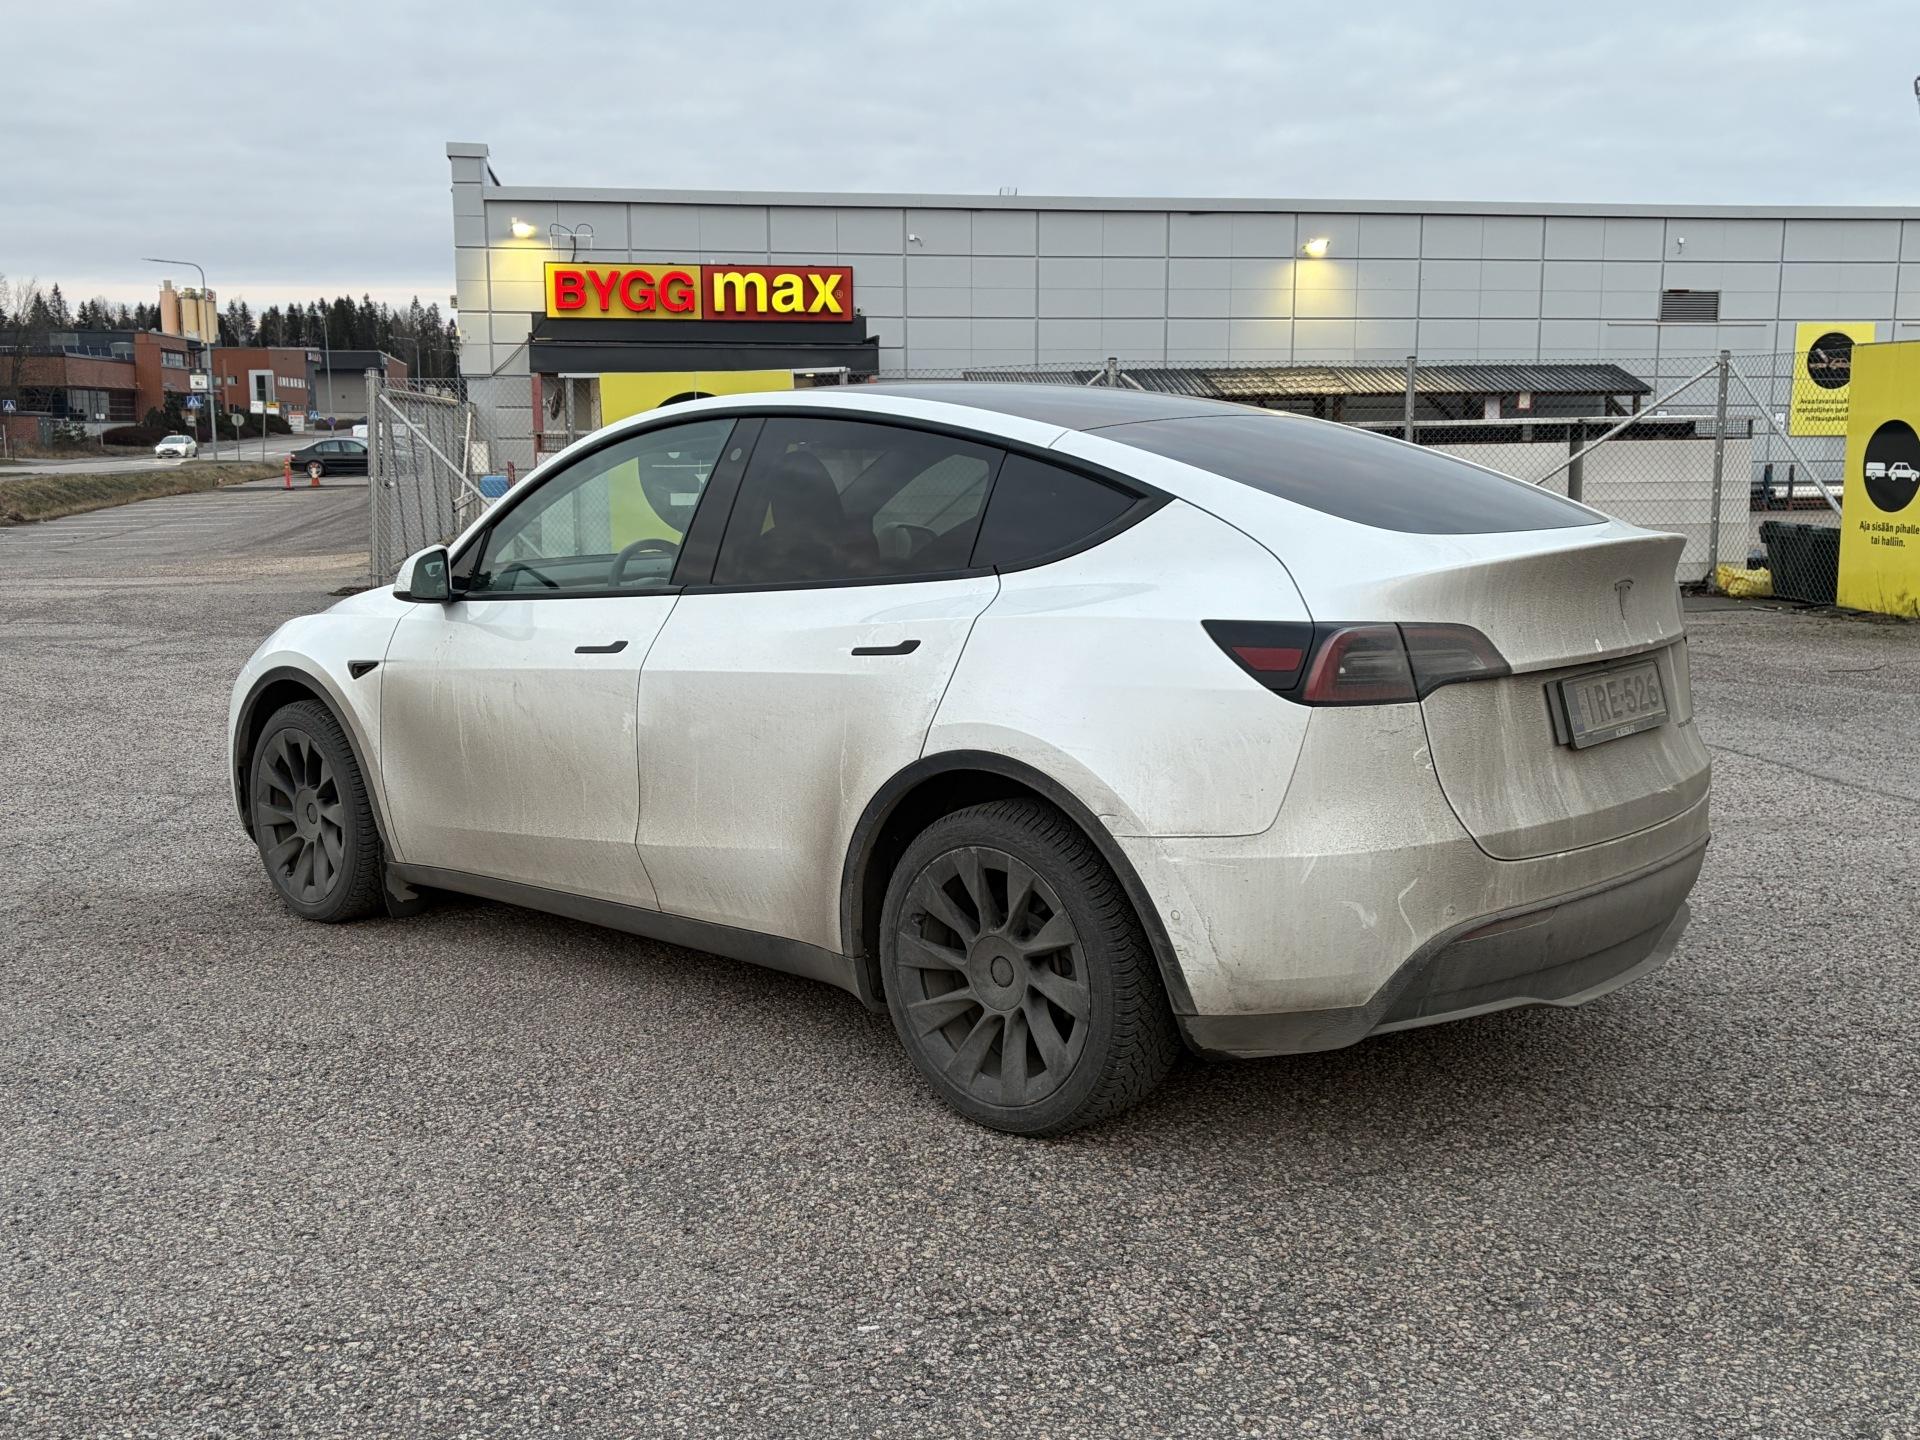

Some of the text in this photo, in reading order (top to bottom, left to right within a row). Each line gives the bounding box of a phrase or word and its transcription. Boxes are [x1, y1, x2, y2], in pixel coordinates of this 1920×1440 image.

[554, 269, 843, 315] BYGG max
[1859, 520, 1920, 535] Aja sisään pihalle
[1871, 535, 1906, 548] tai halliin.
